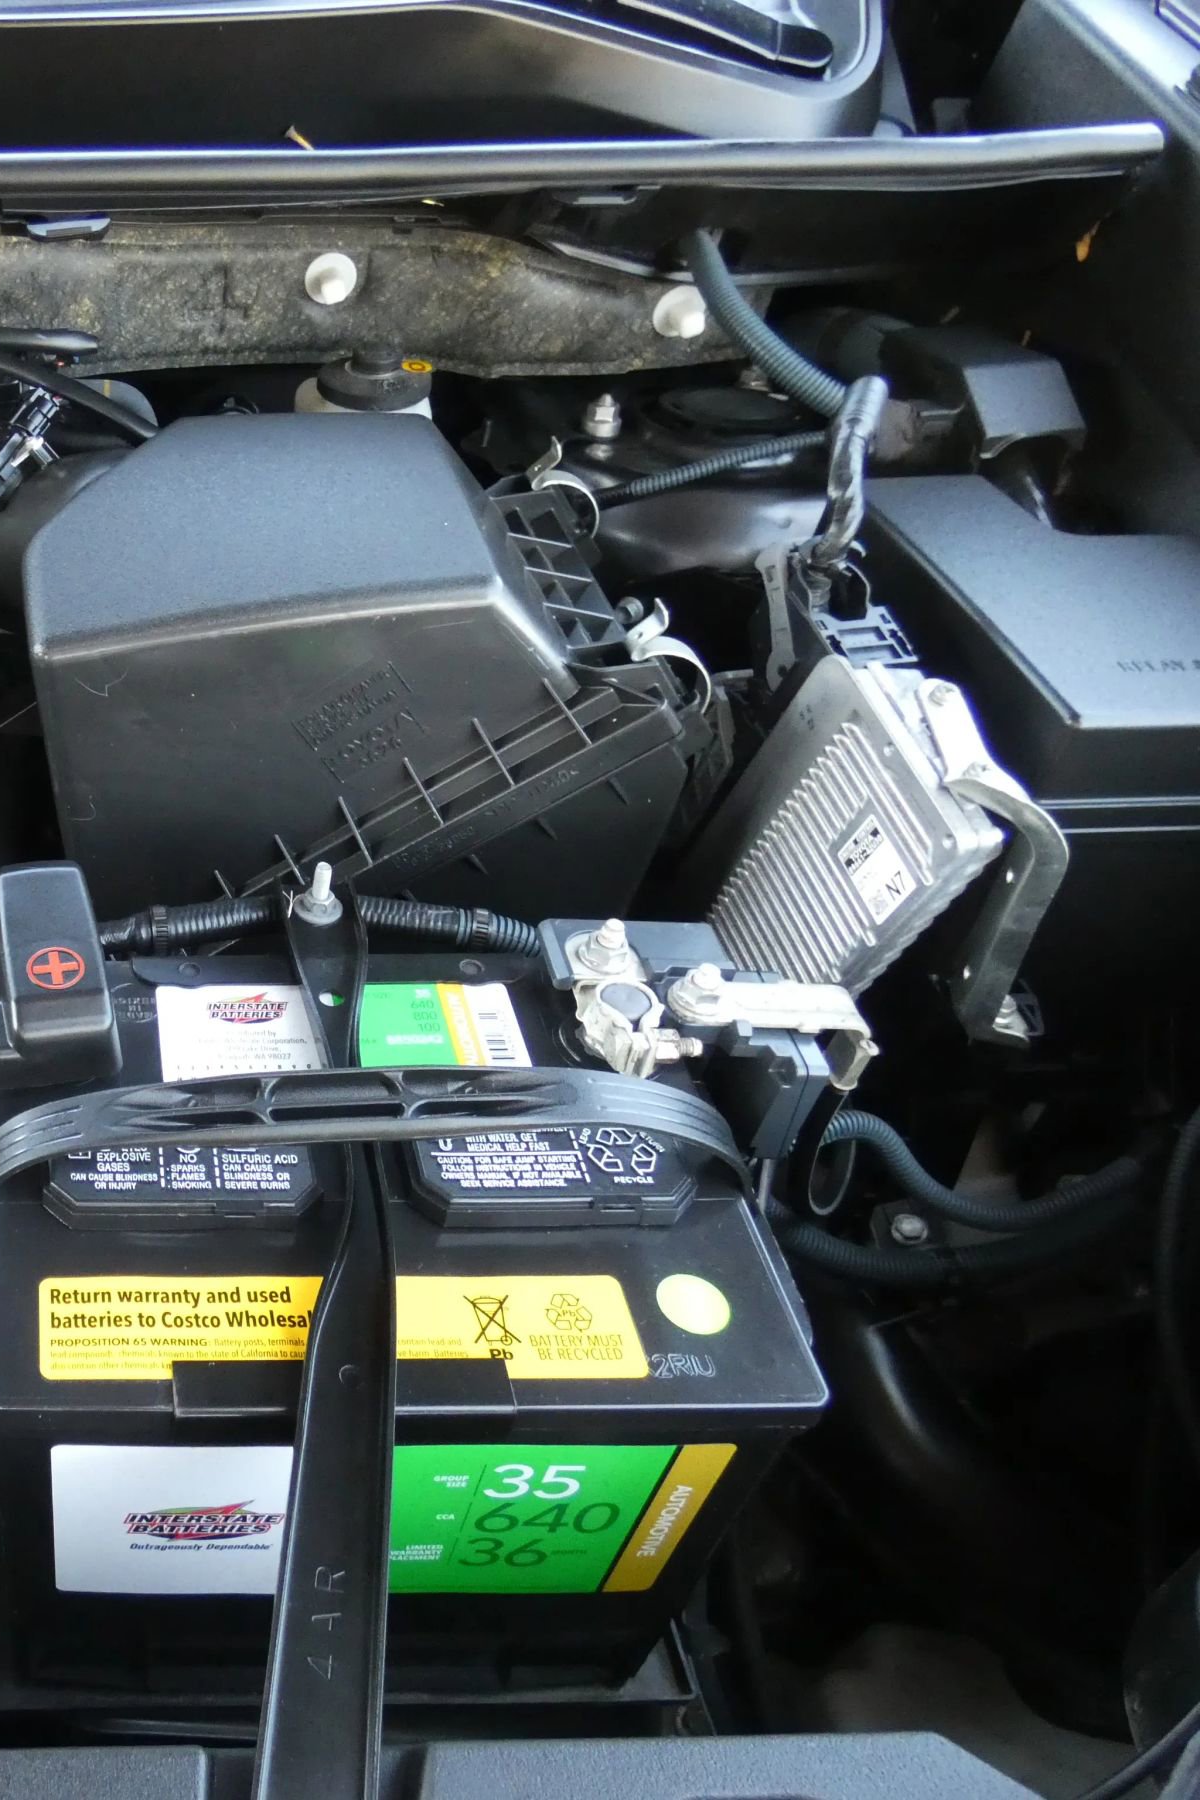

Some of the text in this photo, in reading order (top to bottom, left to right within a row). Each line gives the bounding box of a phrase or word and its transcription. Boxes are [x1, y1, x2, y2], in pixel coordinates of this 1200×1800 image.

[207, 1001, 288, 1011] INTERSTATE
[210, 1010, 284, 1019] BATTERIES
[520, 1132, 538, 1142] GET
[466, 1142, 550, 1152] MEDICAL HELP FAST
[96, 1152, 152, 1162] EXPLOSIVE
[179, 1154, 197, 1163] NO
[222, 1154, 298, 1164] SULFURIC ACID
[96, 1162, 131, 1172] GASES
[171, 1164, 206, 1172] SPARKS
[222, 1164, 274, 1172] CAN CAUSE
[70, 1173, 158, 1181] CAN CAUSE BLINDNESS
[171, 1172, 206, 1180] FLAMES
[223, 1172, 291, 1180] BLINDNESS OR
[613, 1176, 655, 1184] RECYCLE
[94, 1182, 137, 1190] OR INJURY
[172, 1181, 212, 1189] SMOKING
[224, 1181, 259, 1189] SEVERE
[50, 1286, 292, 1308] Return warranty and used
[50, 1309, 312, 1329] batteries to Costco Wholesal
[50, 1337, 130, 1347] PROPOSITION
[133, 1337, 147, 1346] 65
[529, 1334, 624, 1347] BATTERY MUST
[240, 1350, 279, 1358] California
[279, 1350, 288, 1358] to
[489, 1348, 514, 1360] Pb
[538, 1347, 623, 1360] BE RECYCLED
[483, 1463, 587, 1499] 35
[125, 1513, 284, 1524] INTERSTATE
[473, 1502, 621, 1534] 640
[636, 1484, 693, 1557] AUTOMOTIVE
[130, 1524, 272, 1534] BATTERIES
[130, 1543, 202, 1551] Outrageously
[458, 1537, 549, 1567] 36
